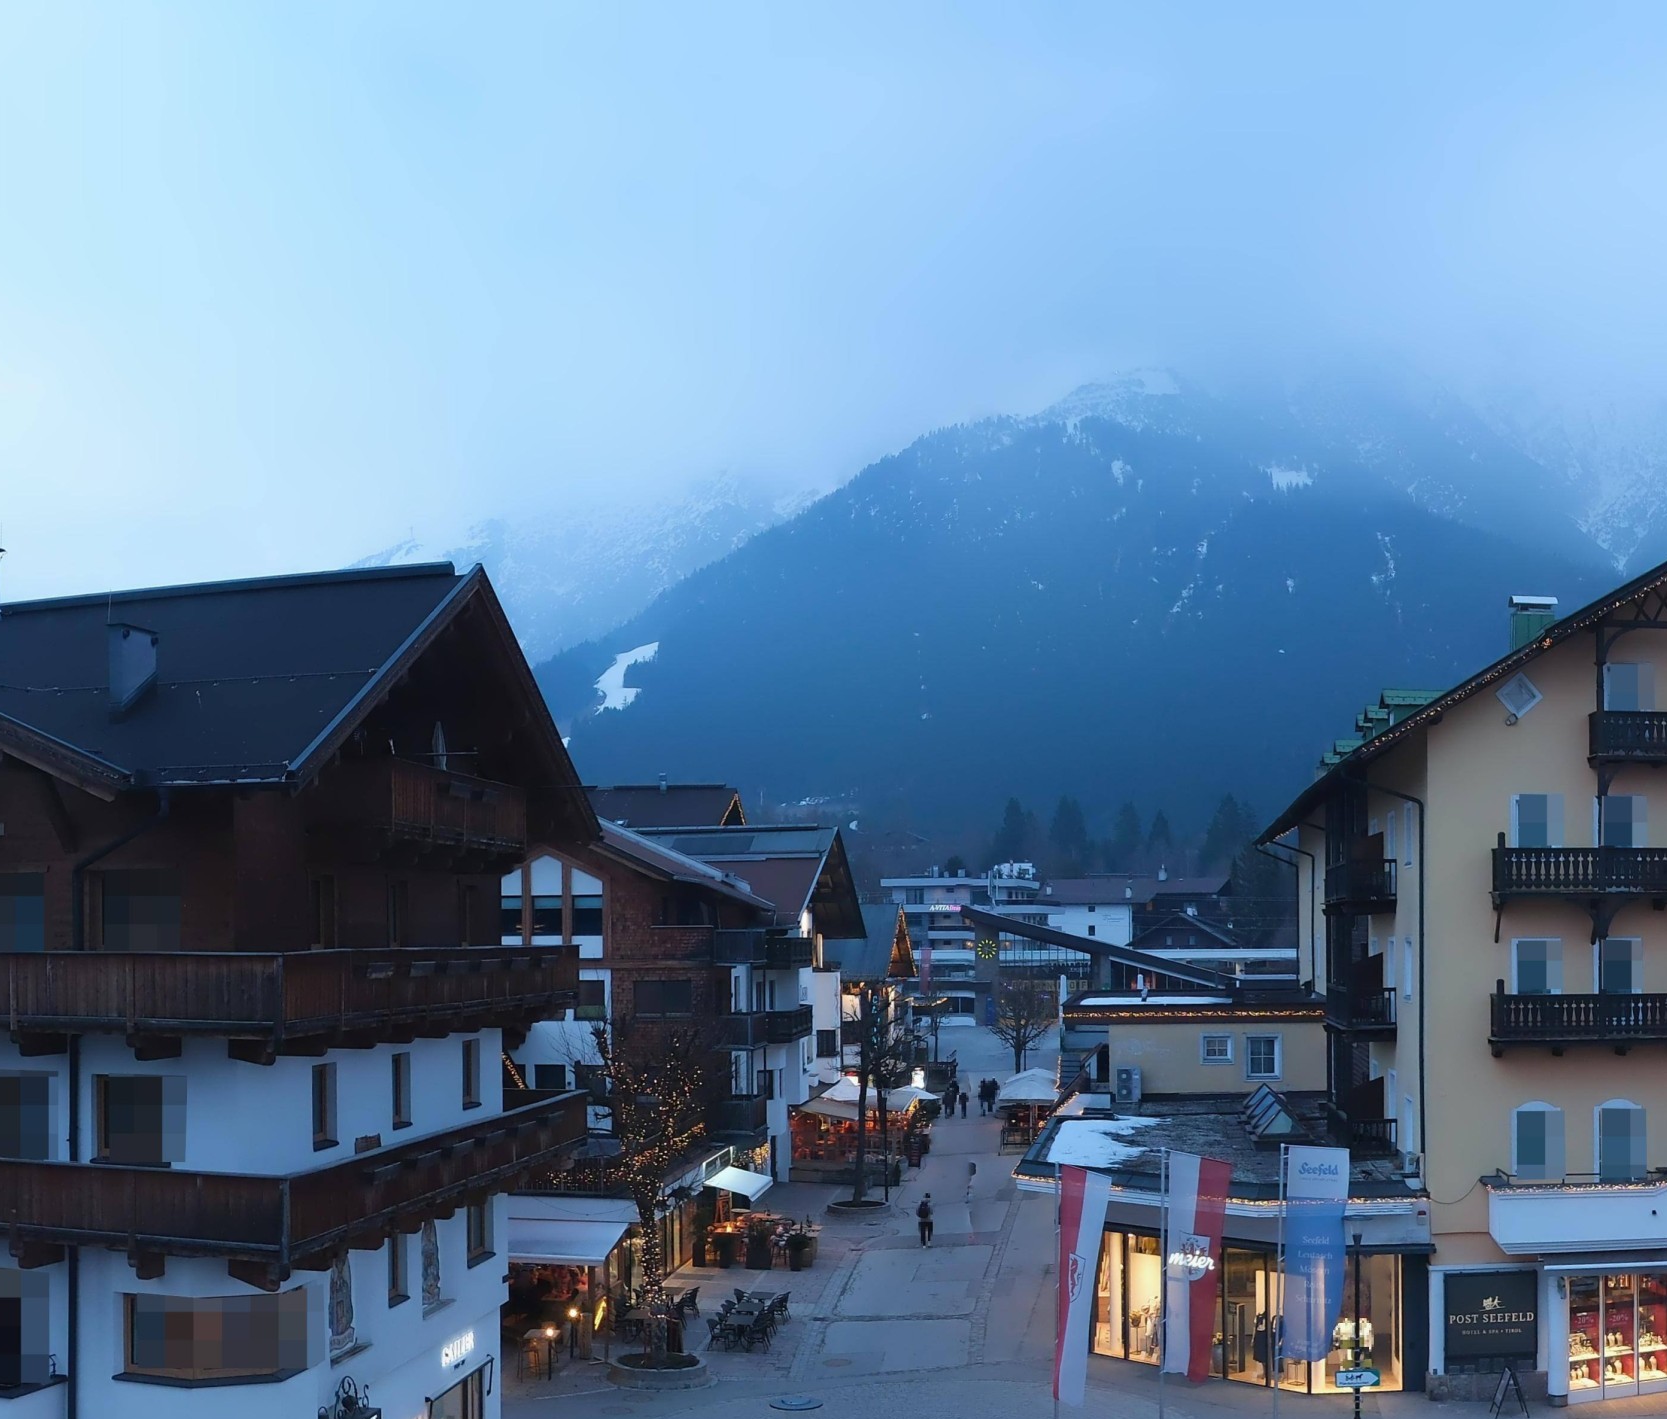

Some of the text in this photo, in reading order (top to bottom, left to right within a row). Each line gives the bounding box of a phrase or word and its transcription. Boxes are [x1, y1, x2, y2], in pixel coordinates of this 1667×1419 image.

[1299, 1162, 1338, 1176] Seefeld
[1302, 1235, 1330, 1245] Seefeld
[1168, 1250, 1215, 1270] meier
[1449, 1312, 1534, 1325] POST SEEFELD
